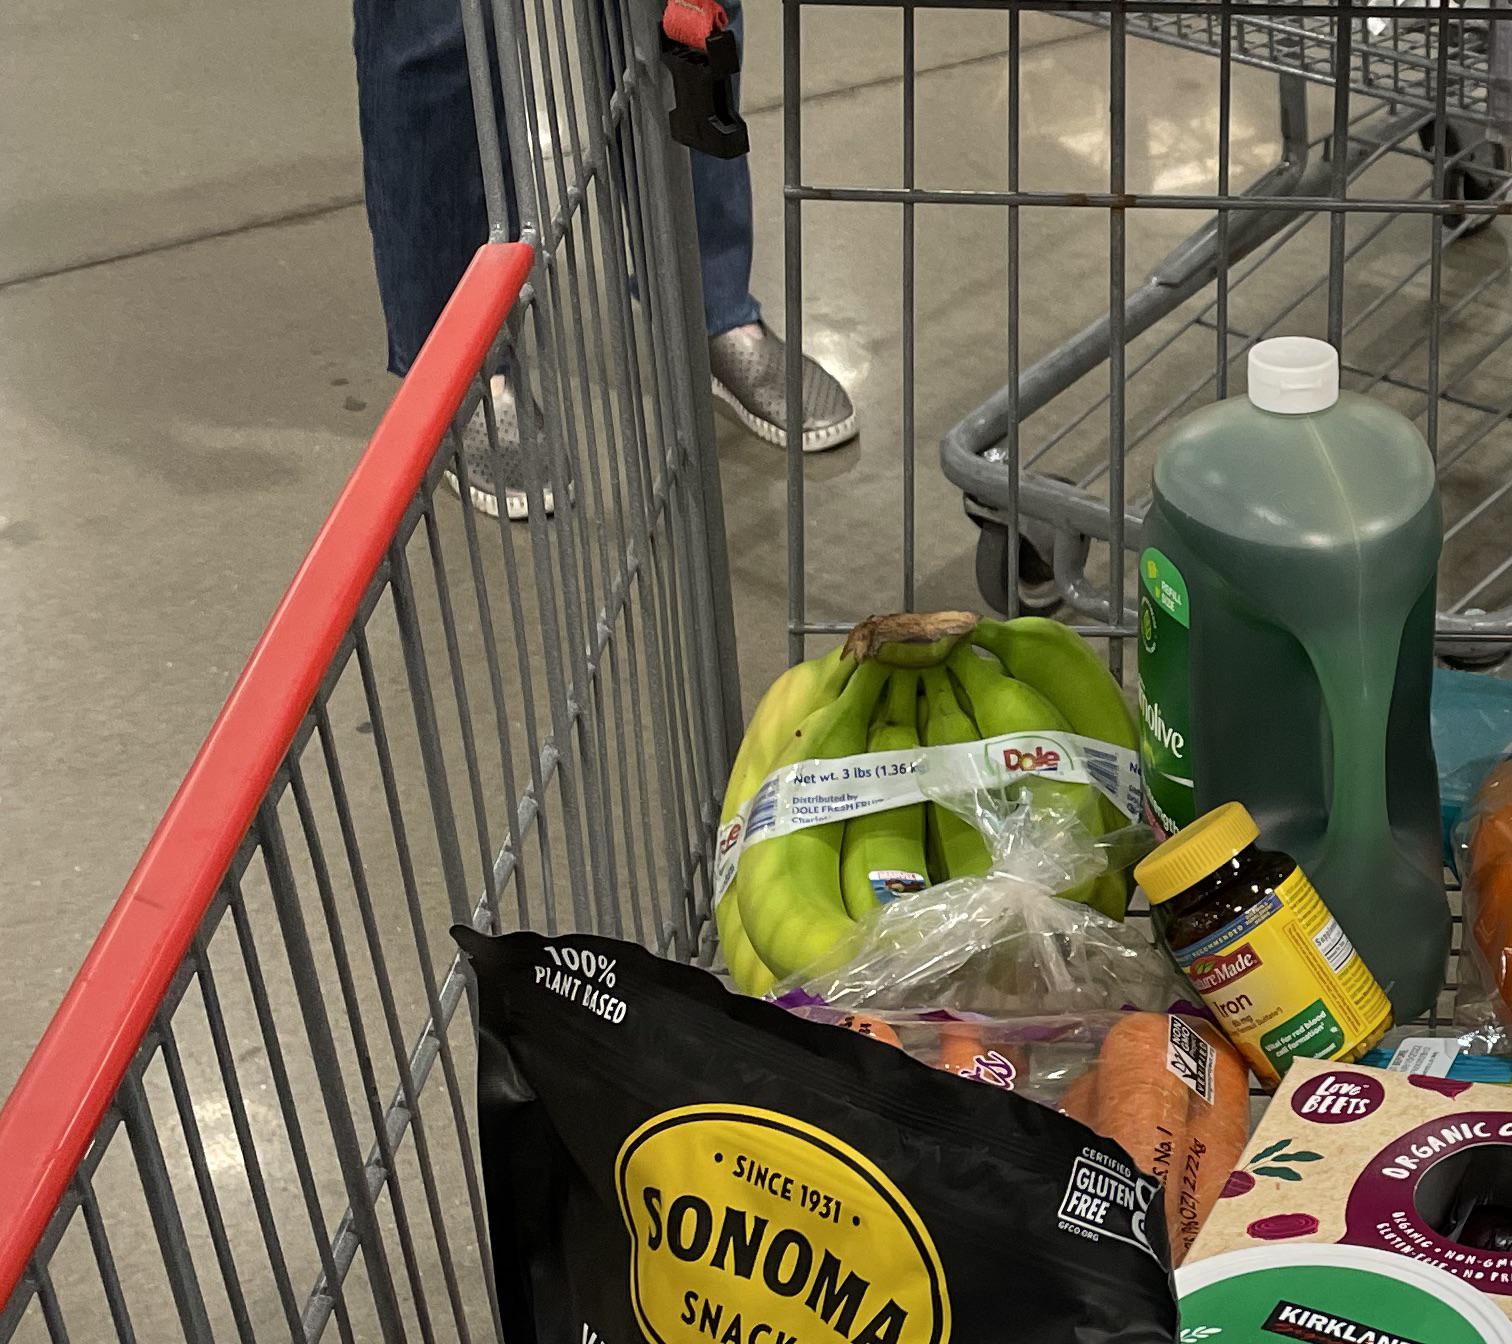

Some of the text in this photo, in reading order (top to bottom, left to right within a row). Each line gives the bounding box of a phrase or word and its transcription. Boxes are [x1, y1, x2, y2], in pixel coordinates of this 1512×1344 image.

[842, 768, 851, 781] 3
[853, 766, 872, 780] lbs
[543, 945, 618, 989] 100%
[534, 964, 628, 1025] PLANT BASED
[1213, 993, 1253, 1019] Iron
[1300, 1093, 1371, 1116] BEETS
[1081, 1146, 1132, 1178] CERTIFIED
[1381, 1120, 1492, 1181] ORGANIC
[731, 1154, 843, 1226] SINCE 1931
[1075, 1166, 1135, 1211] GLUTEN
[1065, 1191, 1111, 1225] FREE
[1391, 1211, 1434, 1248] ORGANIC
